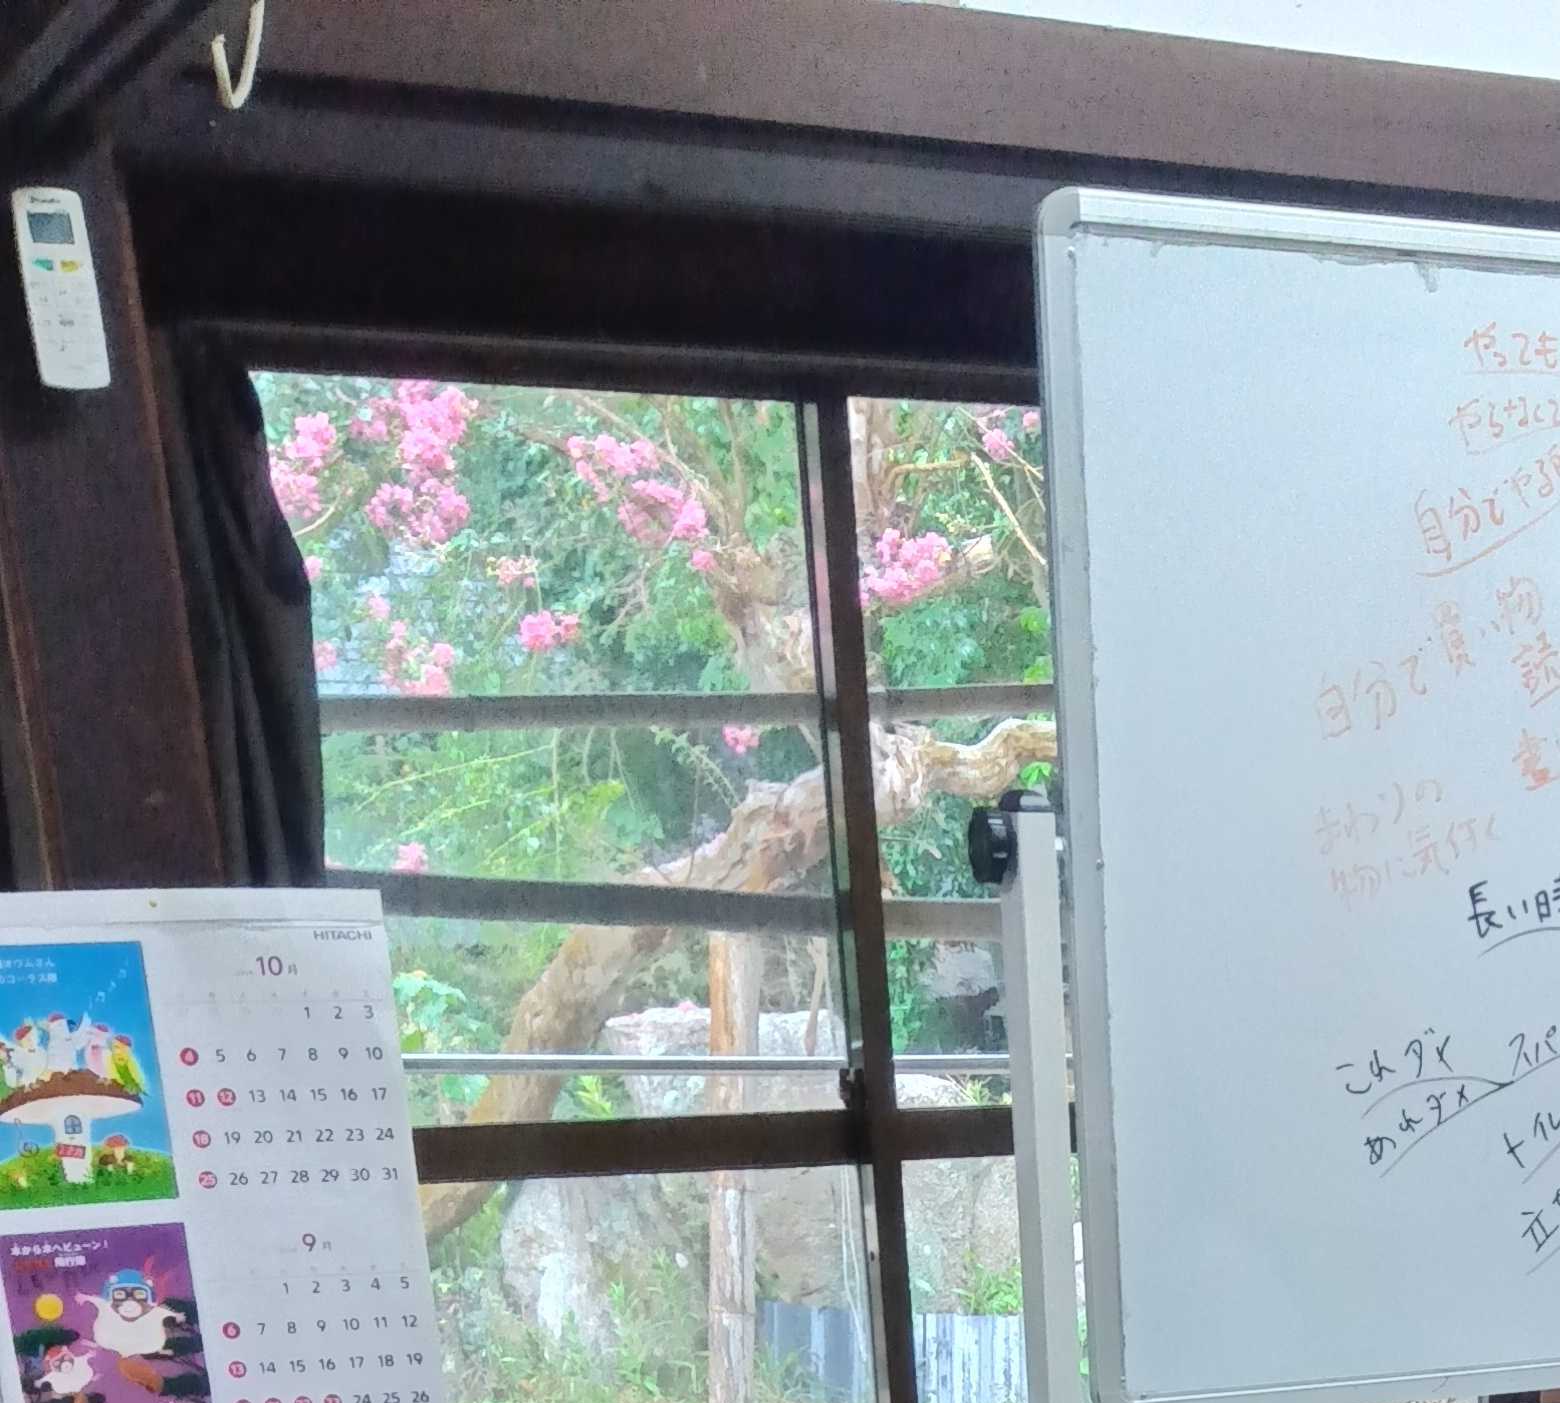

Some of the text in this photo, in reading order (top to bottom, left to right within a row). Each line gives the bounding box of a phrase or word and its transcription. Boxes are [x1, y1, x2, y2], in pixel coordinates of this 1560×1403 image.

[312, 929, 373, 942] HITACHI
[333, 1006, 343, 1019] 2
[363, 1005, 375, 1019] 3
[215, 1049, 226, 1062] 5
[246, 1048, 257, 1062] 6
[278, 1048, 286, 1061] 7
[308, 1047, 318, 1061] 8
[338, 1047, 348, 1061] 9
[365, 1046, 384, 1060] 10
[249, 1090, 266, 1103] 13
[280, 1089, 297, 1102] 14
[310, 1088, 327, 1101] 15
[341, 1088, 358, 1101] 16
[371, 1087, 387, 1100] 17
[224, 1131, 241, 1145] 19
[254, 1130, 273, 1144] 20
[286, 1129, 302, 1143] 21
[315, 1129, 334, 1142] 22
[345, 1128, 364, 1141] 23
[375, 1127, 394, 1141] 24
[229, 1172, 248, 1186] 26
[260, 1171, 278, 1184] 27
[290, 1170, 310, 1183] 28
[321, 1169, 340, 1183] 29
[351, 1168, 370, 1181] 30
[382, 1167, 398, 1181] 31
[312, 1281, 320, 1294] 2
[341, 1279, 351, 1292] 3
[370, 1277, 381, 1291] 4
[400, 1276, 409, 1290] 5
[257, 1322, 266, 1335] 7
[287, 1321, 297, 1334] 8
[316, 1320, 326, 1333] 9
[342, 1318, 360, 1331] 10
[373, 1316, 388, 1329] 11
[401, 1315, 418, 1328] 12
[259, 1361, 276, 1374] 14
[289, 1360, 306, 1373] 15
[319, 1358, 336, 1371] 16
[349, 1356, 364, 1369] 17
[377, 1354, 394, 1367] 18
[406, 1353, 423, 1365] 19
[411, 1391, 430, 1403] 26
